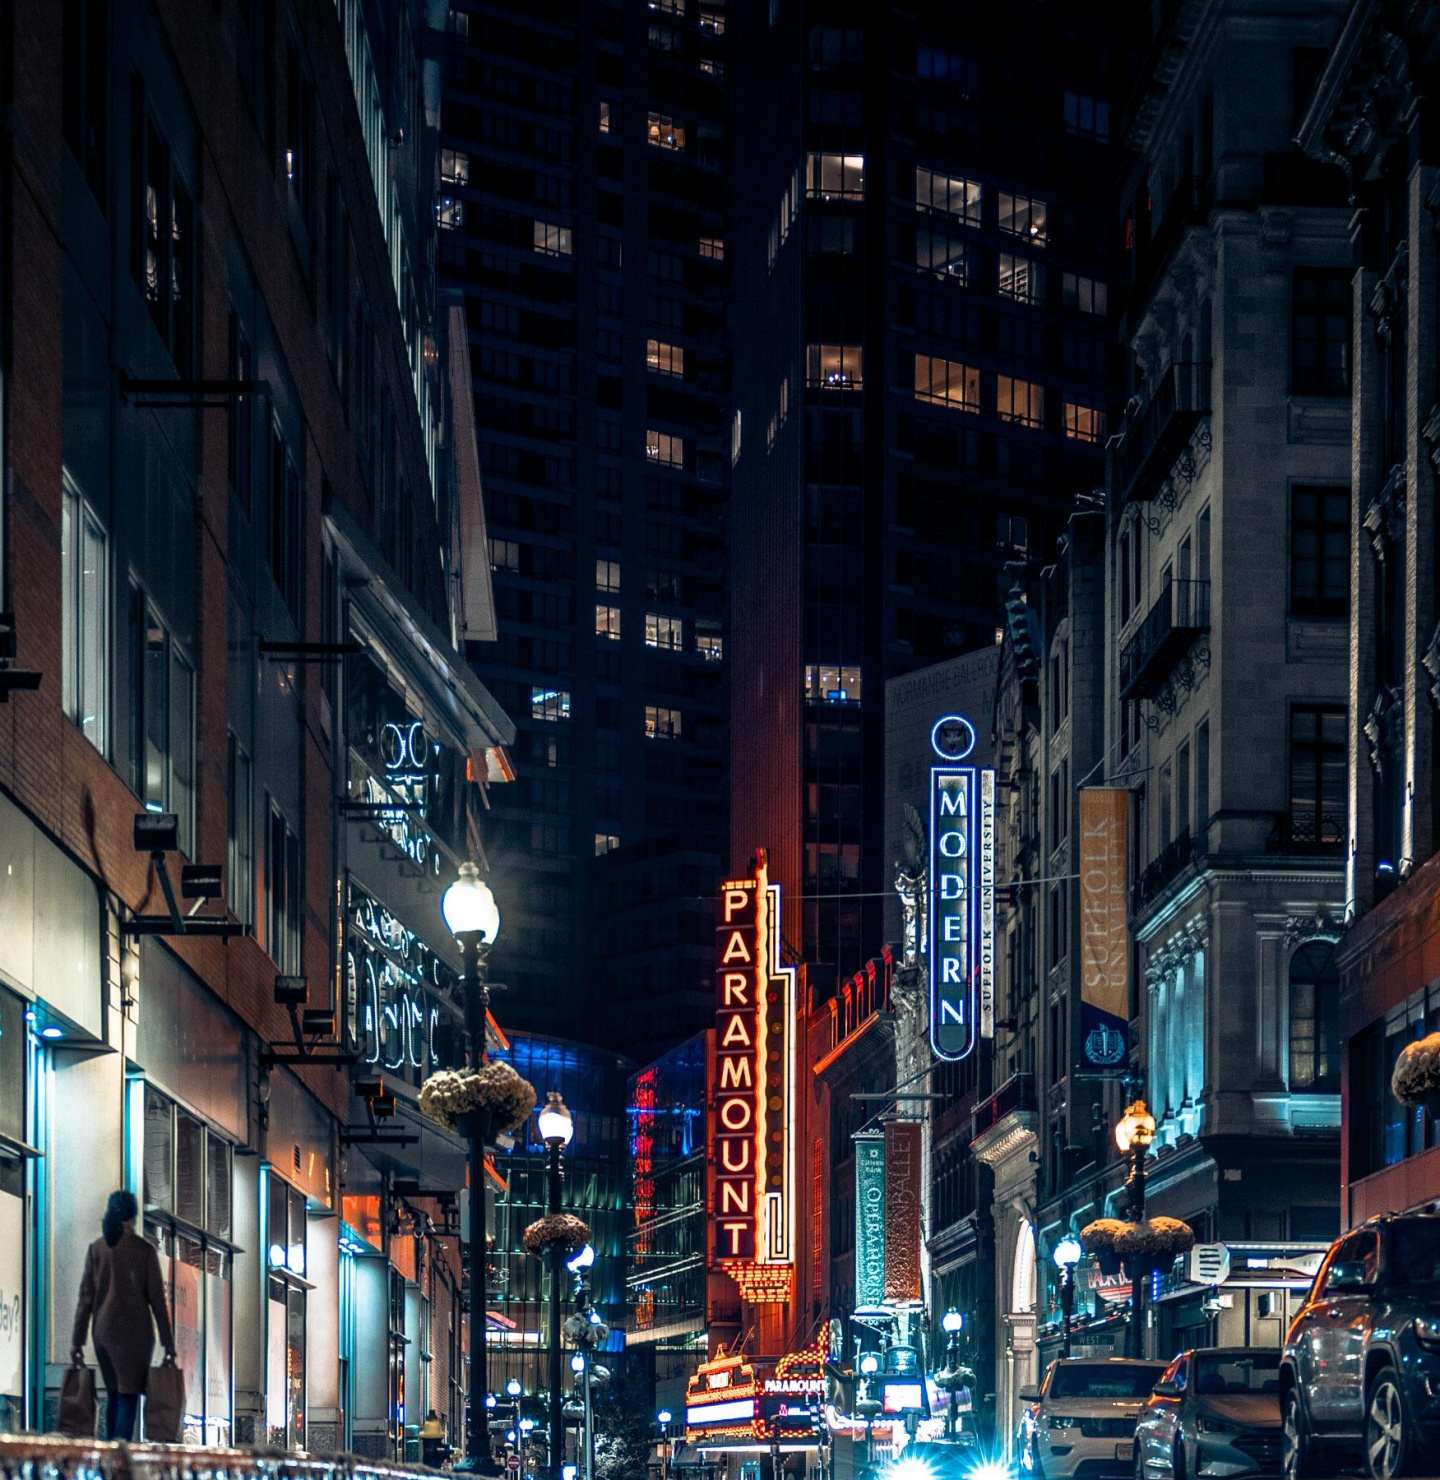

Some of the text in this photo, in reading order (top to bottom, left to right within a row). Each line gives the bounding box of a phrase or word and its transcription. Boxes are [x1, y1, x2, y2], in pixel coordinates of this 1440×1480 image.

[939, 790, 968, 1025] MODERN
[982, 799, 993, 1012] SUFFOLK UNIVERSITY
[1083, 817, 1109, 988] SUFFOLK
[1110, 817, 1128, 988] UNIVERSITY
[721, 889, 752, 1255] PARAMOUNT
[866, 1187, 882, 1305] OPERA HOUSE
[764, 1379, 826, 1393] PARAMOUNT
[1078, 1335, 1100, 1345] WEST
